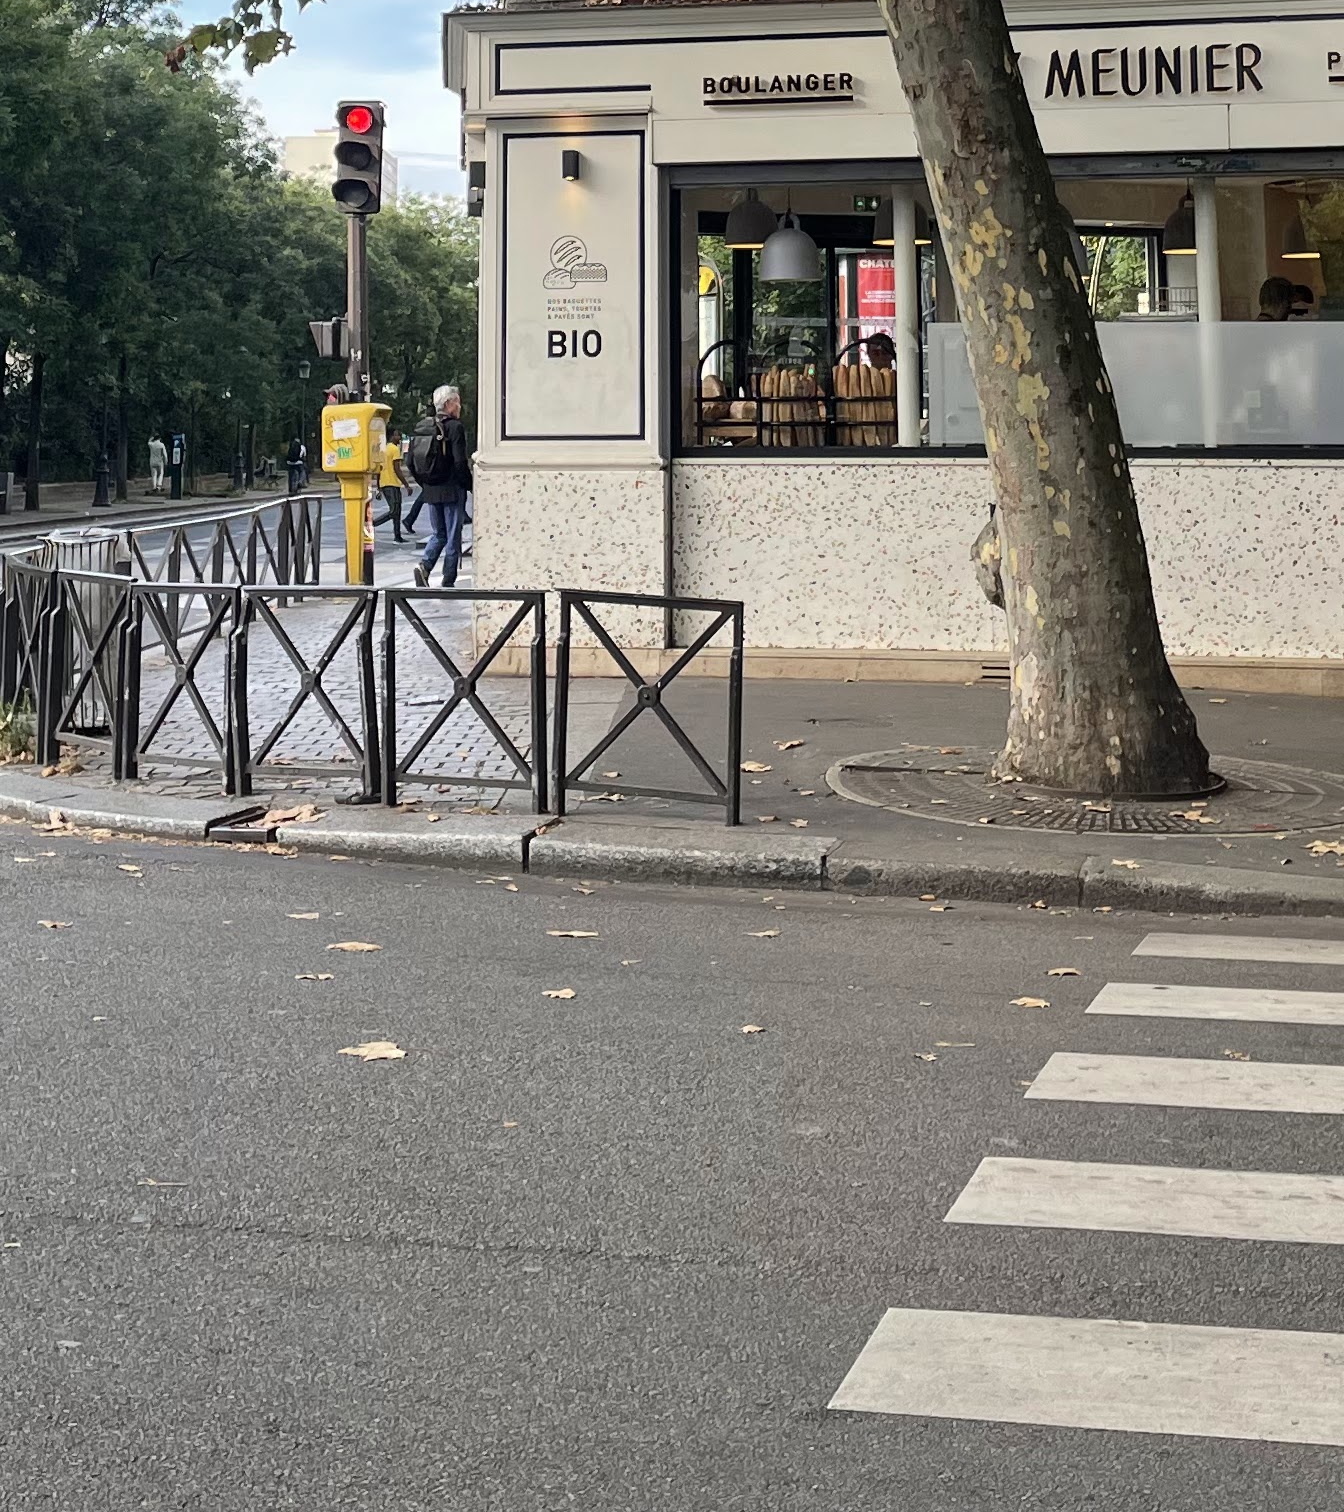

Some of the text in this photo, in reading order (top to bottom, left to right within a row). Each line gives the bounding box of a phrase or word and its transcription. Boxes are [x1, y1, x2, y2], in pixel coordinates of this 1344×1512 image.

[703, 72, 854, 94] BOULANGER
[1044, 43, 1264, 99] MEUNIER
[547, 330, 602, 358] BIO
